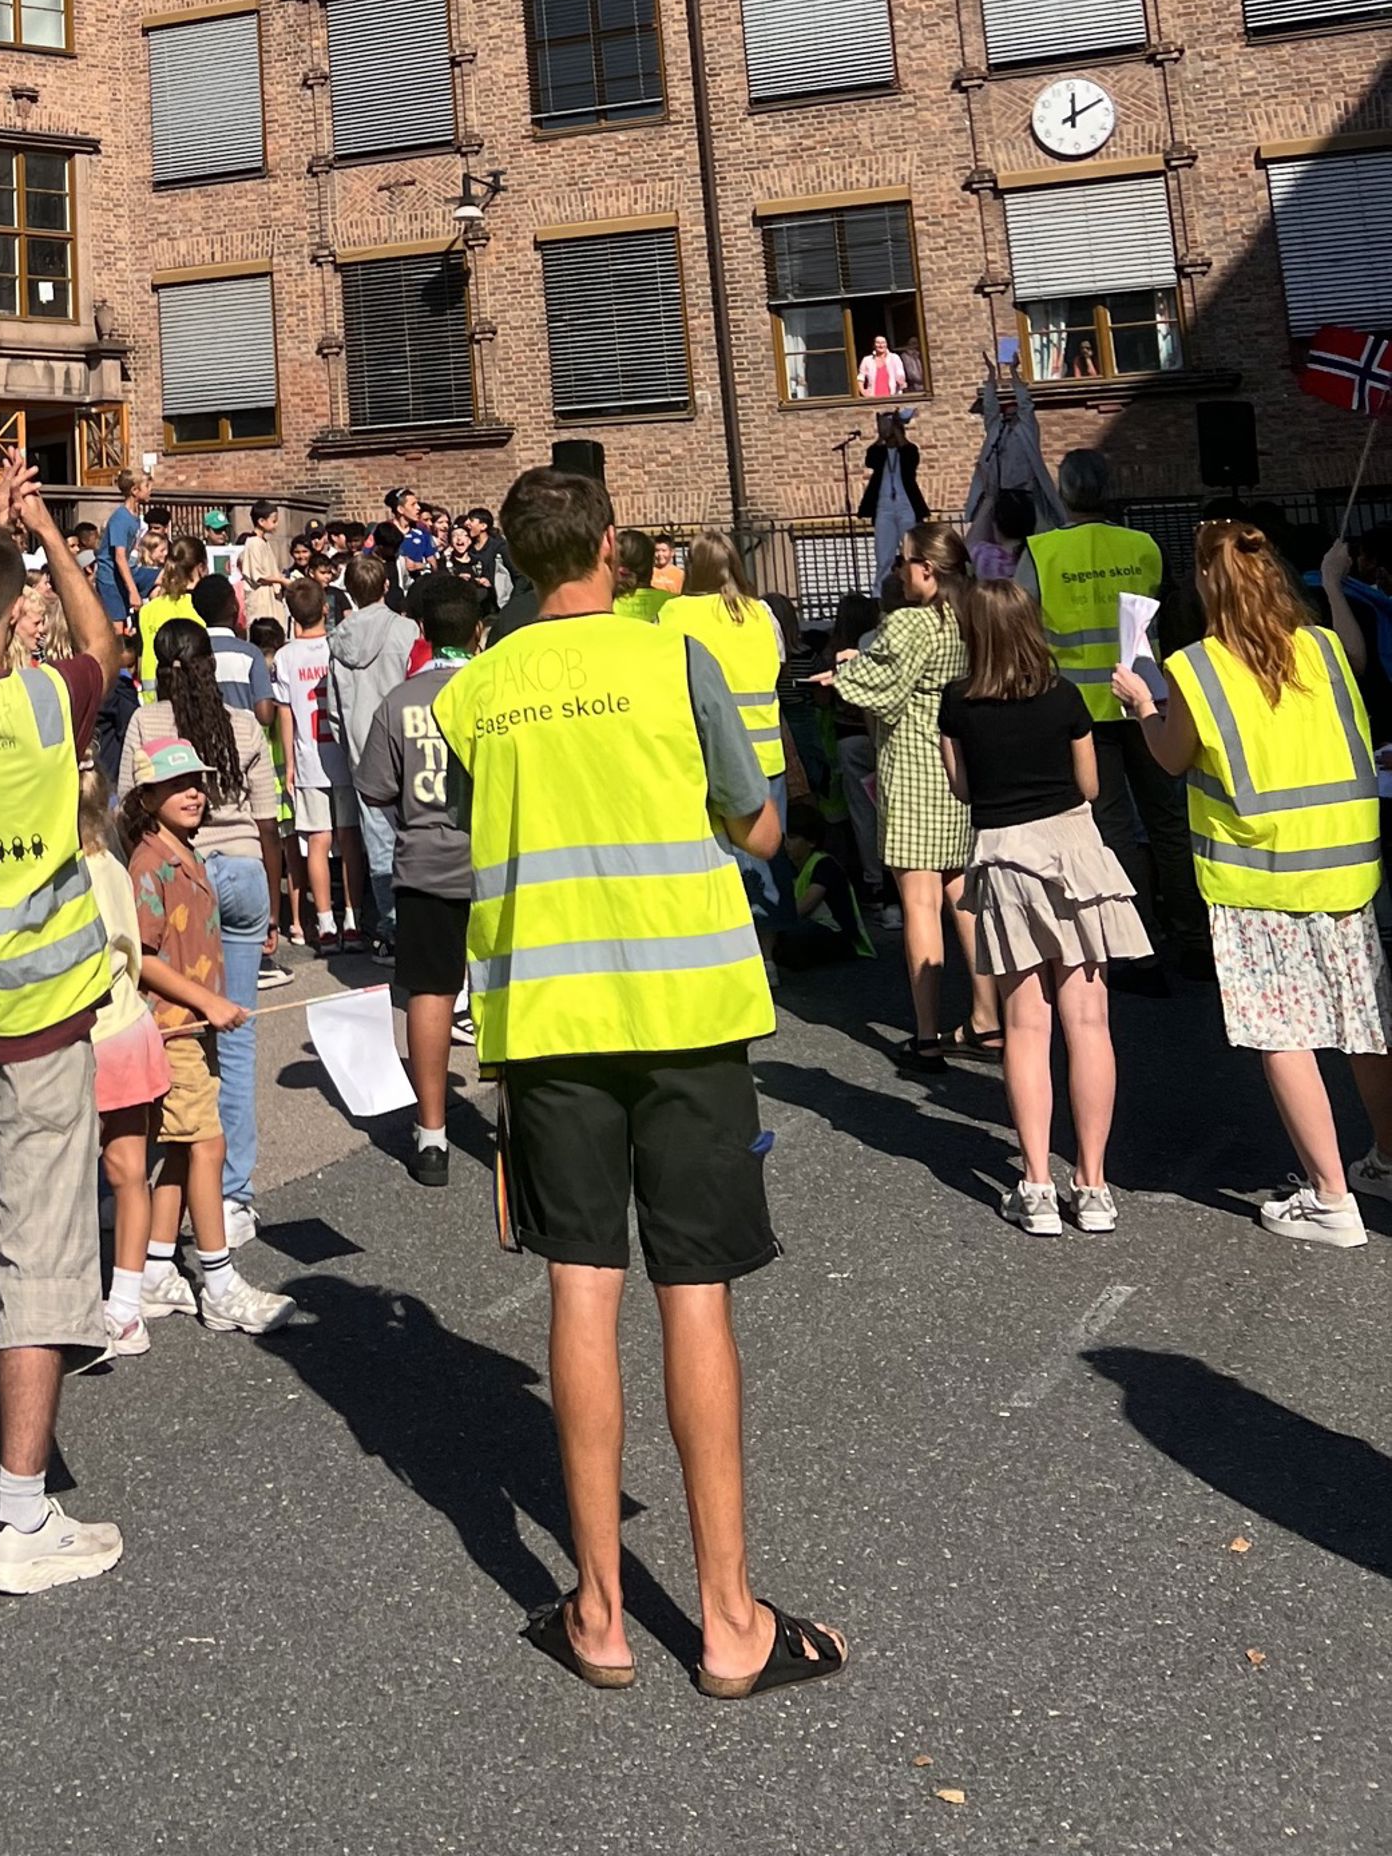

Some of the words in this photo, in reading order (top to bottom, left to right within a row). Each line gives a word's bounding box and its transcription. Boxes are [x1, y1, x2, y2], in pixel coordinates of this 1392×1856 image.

[1062, 569, 1106, 583] Sagene
[1109, 565, 1142, 577] skole
[471, 648, 587, 705] JAKOB
[562, 692, 630, 718] skole
